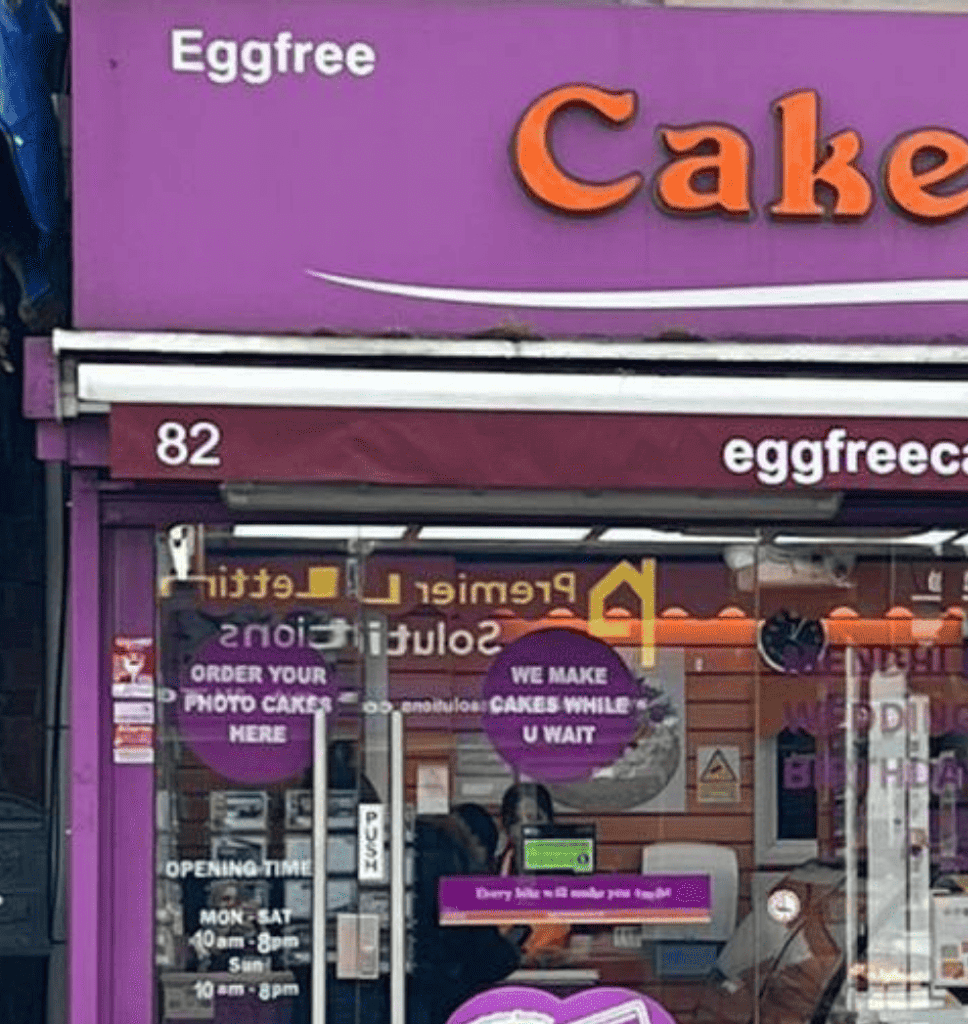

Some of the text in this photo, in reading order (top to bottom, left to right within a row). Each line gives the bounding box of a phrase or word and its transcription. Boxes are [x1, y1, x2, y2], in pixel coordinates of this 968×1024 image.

[171, 29, 376, 83] Eggfree
[155, 423, 222, 466] 82
[190, 664, 327, 685] ORDER YOUR
[510, 666, 608, 685] WE MAKE
[184, 694, 333, 714] PHOTO CAKES
[489, 696, 630, 715] CAKES WHILE
[229, 724, 287, 743] HERE
[522, 726, 597, 744] U WAIT
[365, 811, 379, 873] PUSH
[165, 861, 257, 877] OPENING
[200, 910, 243, 925] MON
[257, 910, 292, 925] SAT
